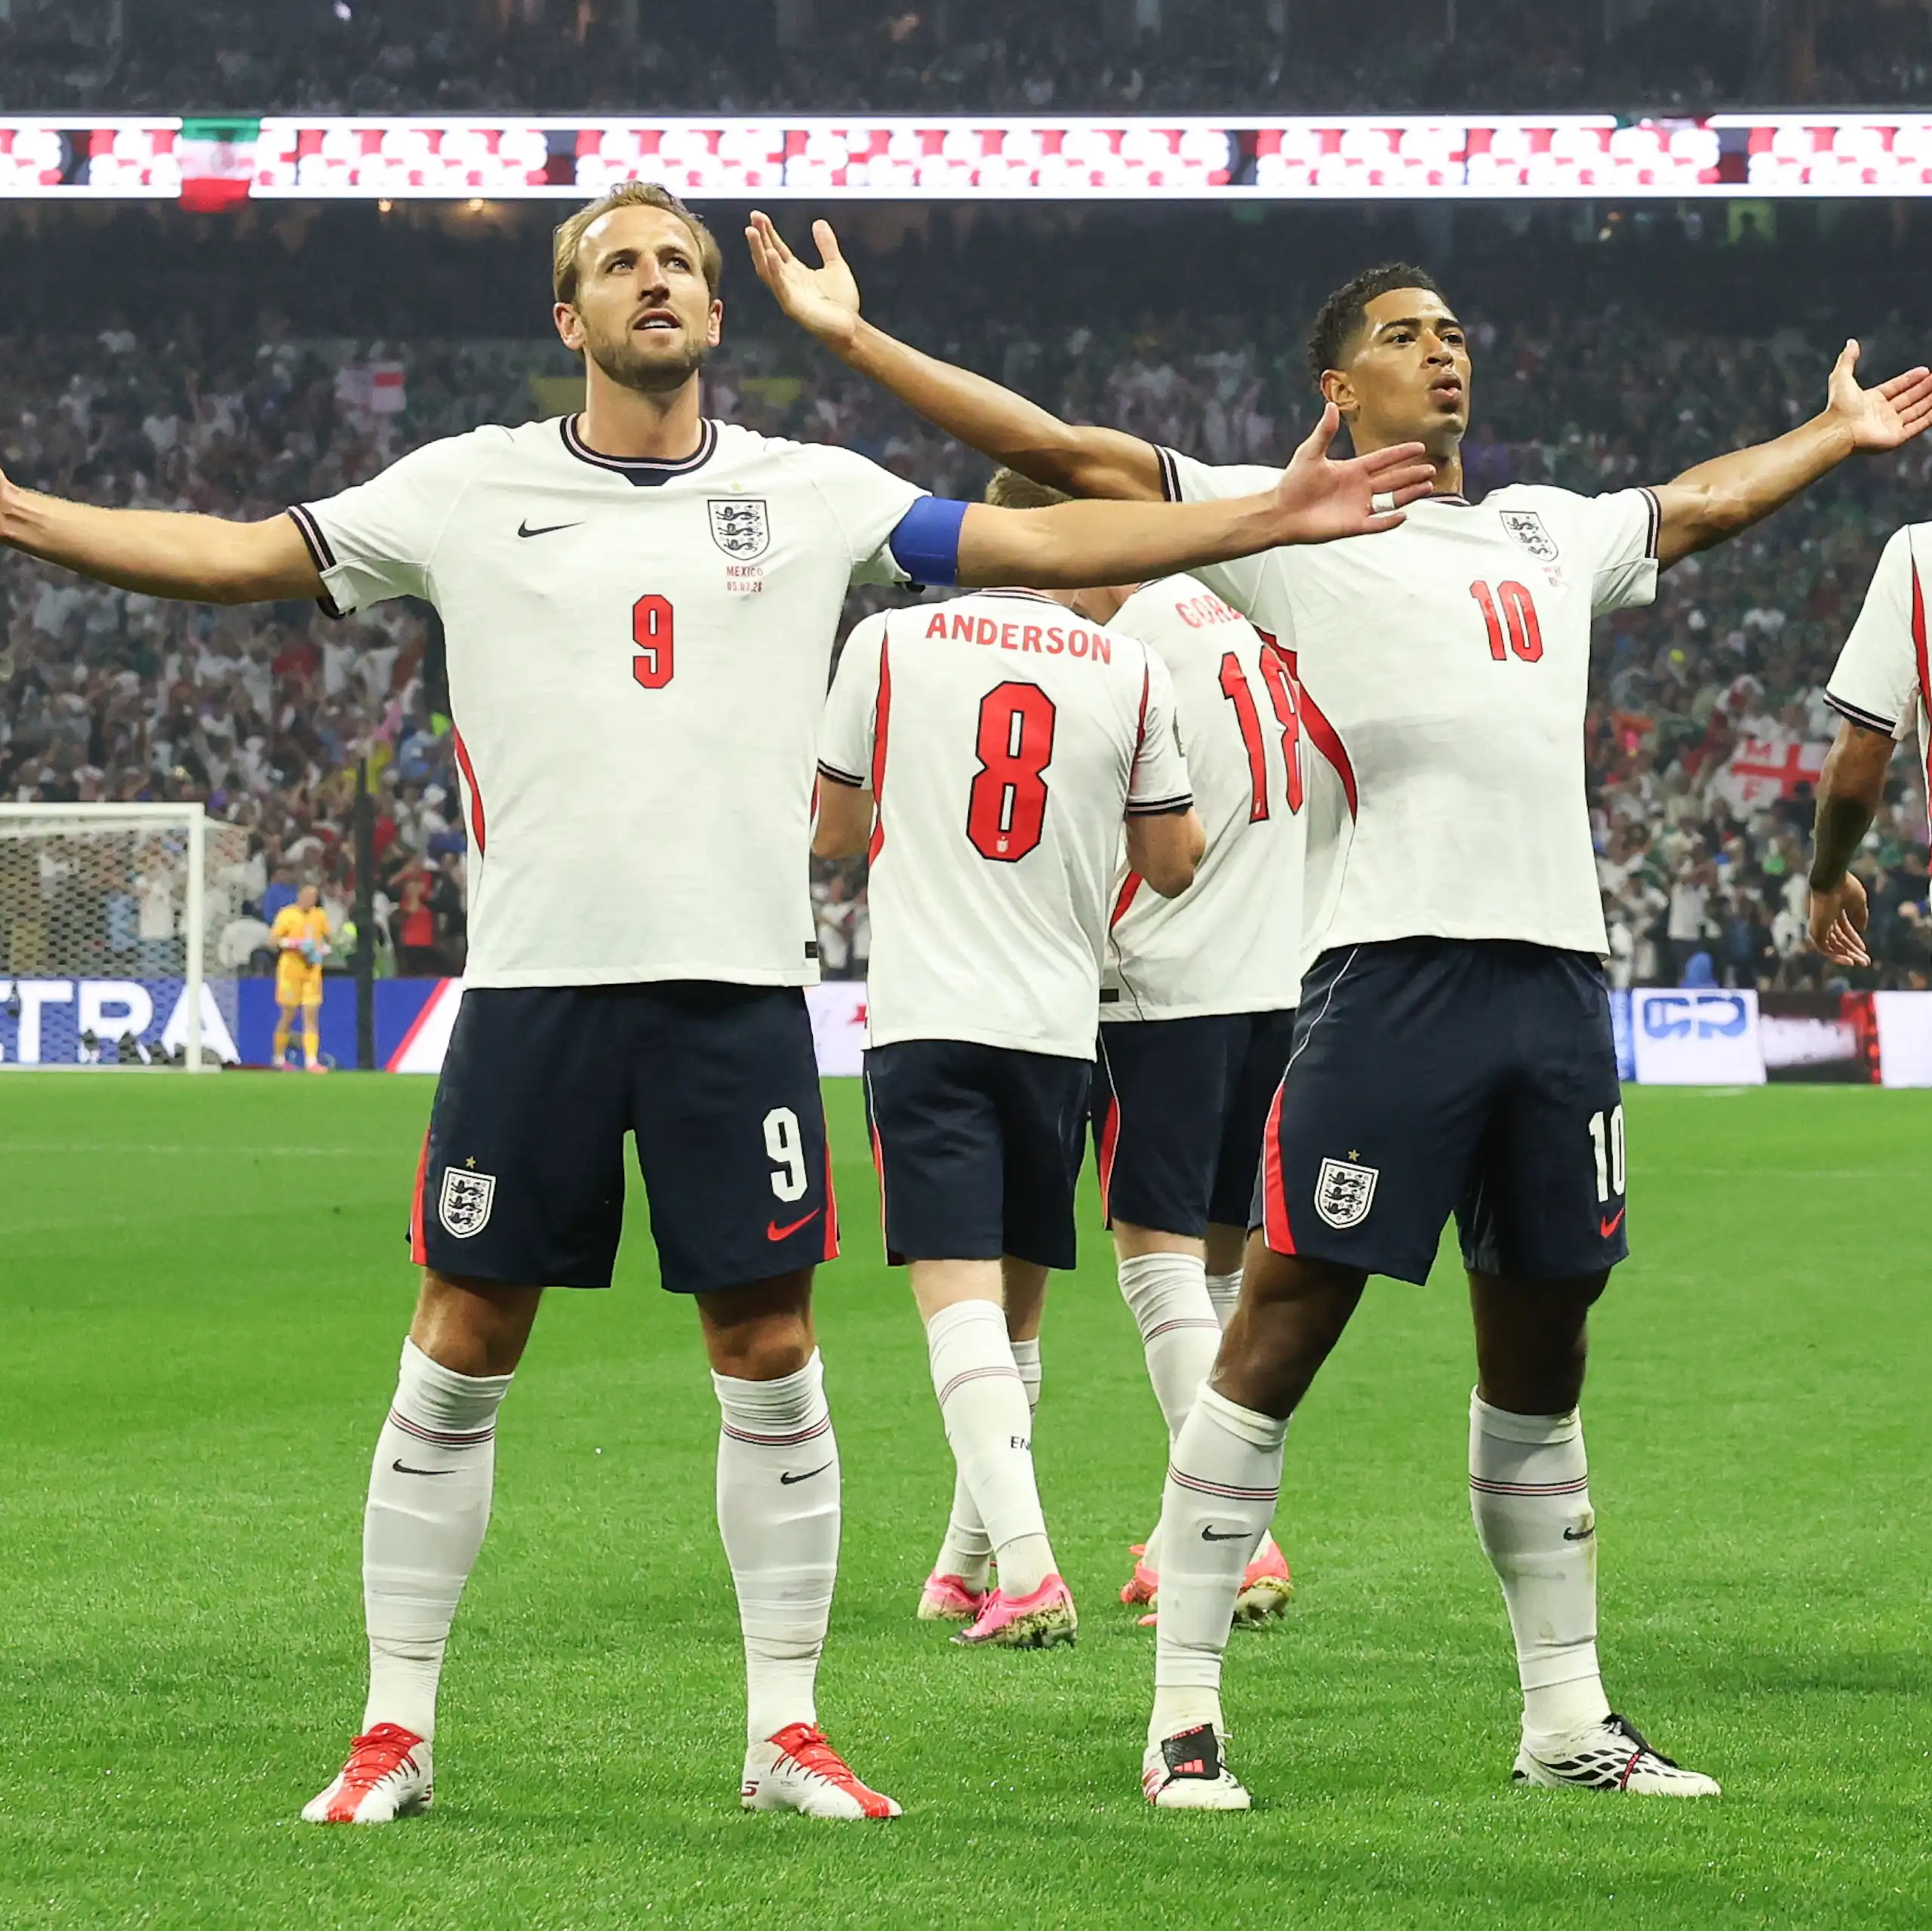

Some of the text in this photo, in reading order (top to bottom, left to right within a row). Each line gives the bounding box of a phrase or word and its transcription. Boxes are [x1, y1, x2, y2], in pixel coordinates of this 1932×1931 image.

[726, 566, 763, 577] MEXICO
[632, 594, 673, 689] 9
[925, 613, 1111, 665] ANDERSON
[1469, 580, 1543, 663] 10
[966, 681, 1057, 863] 8
[1218, 645, 1303, 824] 18
[762, 1107, 808, 1202] 9
[1589, 1104, 1626, 1203] 10
